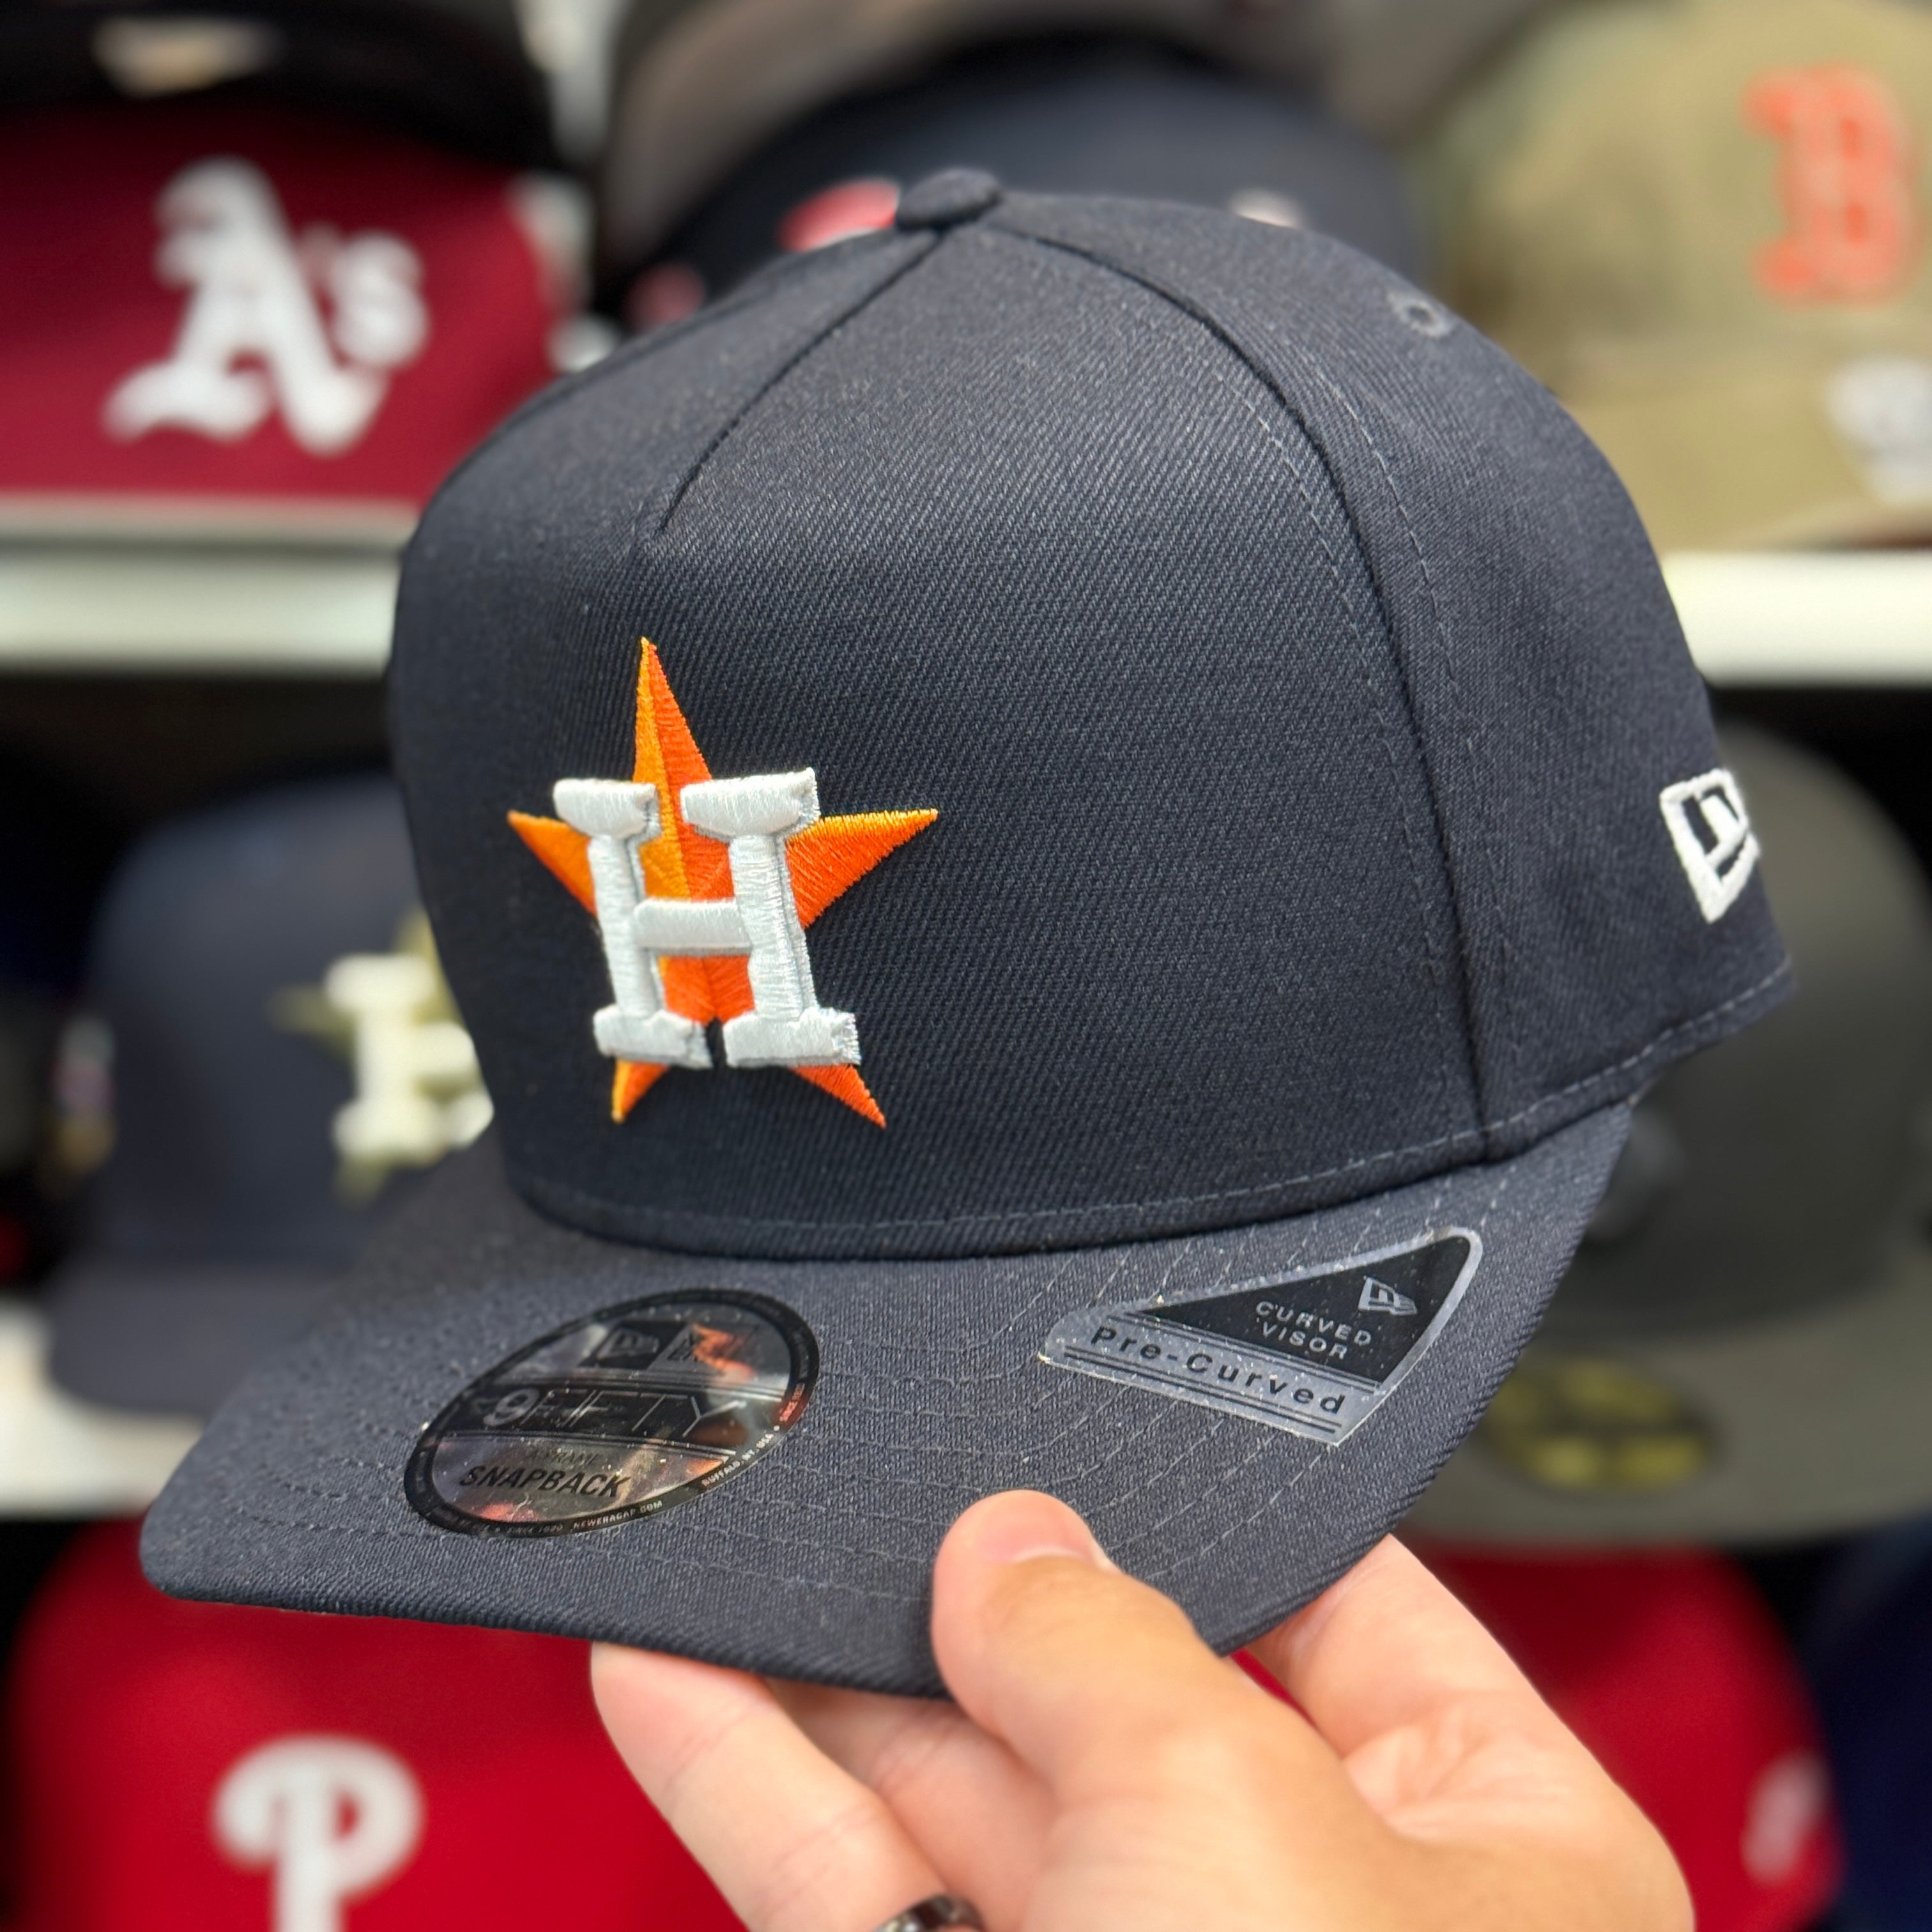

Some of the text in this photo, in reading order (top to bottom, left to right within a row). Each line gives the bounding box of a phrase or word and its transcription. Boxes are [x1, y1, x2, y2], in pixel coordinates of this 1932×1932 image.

[1743, 66, 1913, 303] B
[553, 768, 861, 1070] H
[1255, 1301, 1372, 1346] CURVED
[1262, 1321, 1348, 1360] VISOR
[1090, 1325, 1346, 1415] Pre-Curved
[459, 1464, 631, 1498] SNAPBACK
[212, 1735, 423, 1932] P
